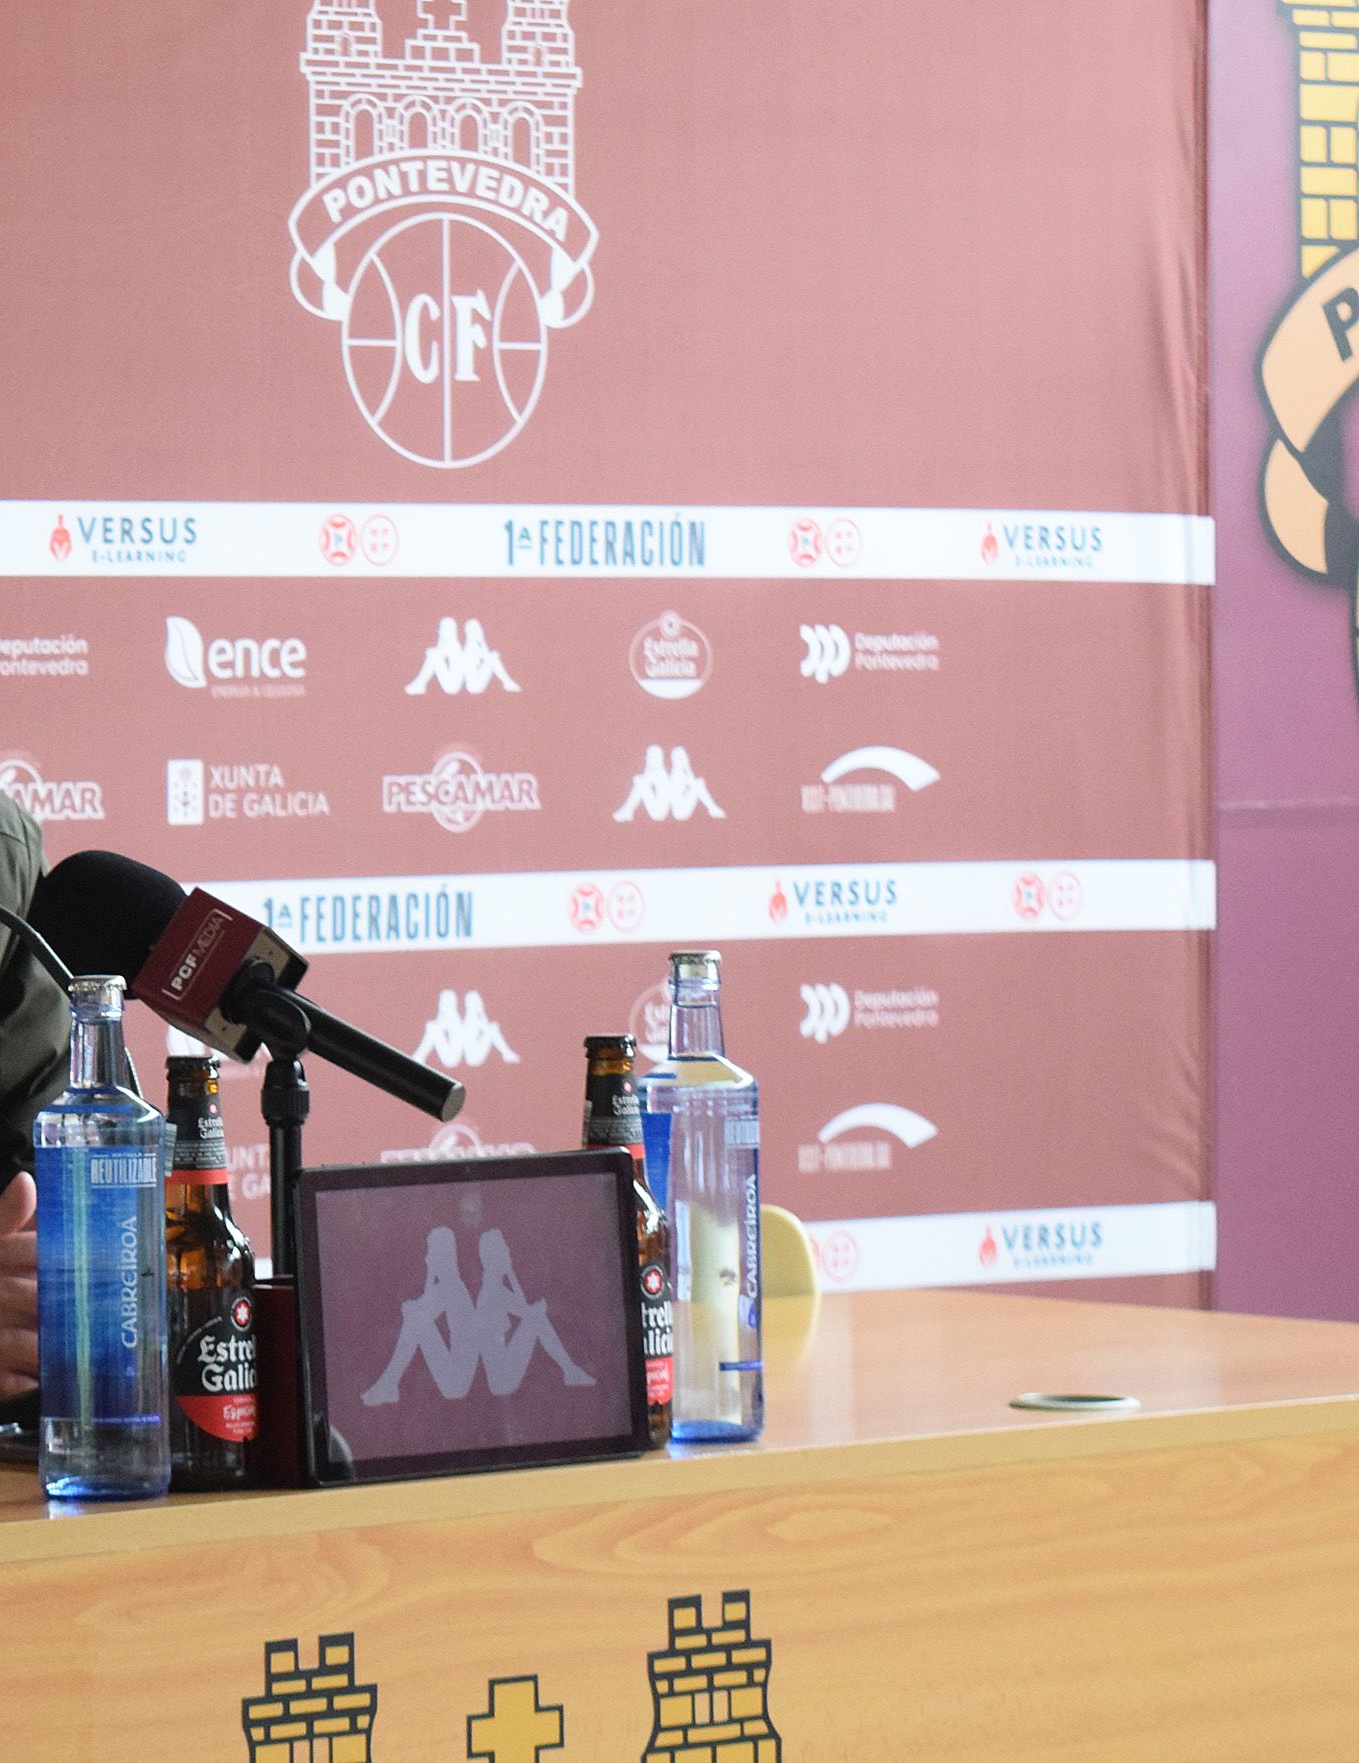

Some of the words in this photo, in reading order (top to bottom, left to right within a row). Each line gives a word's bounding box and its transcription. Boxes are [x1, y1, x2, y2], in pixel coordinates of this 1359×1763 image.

[322, 159, 570, 243] PONTEVEDRA
[78, 516, 197, 544] VERSUS
[540, 513, 706, 567] FEDERACIÓN
[1003, 525, 1103, 551] VERSUS
[208, 638, 307, 679] ence
[210, 764, 285, 789] XUNTA
[208, 793, 237, 818] DE
[242, 791, 330, 818] GALICIA
[382, 773, 541, 813] PESCAMAR
[793, 879, 898, 907] VERSUS
[300, 884, 474, 943] FEDERACIÓN
[1002, 1221, 1103, 1251] VERSUS
